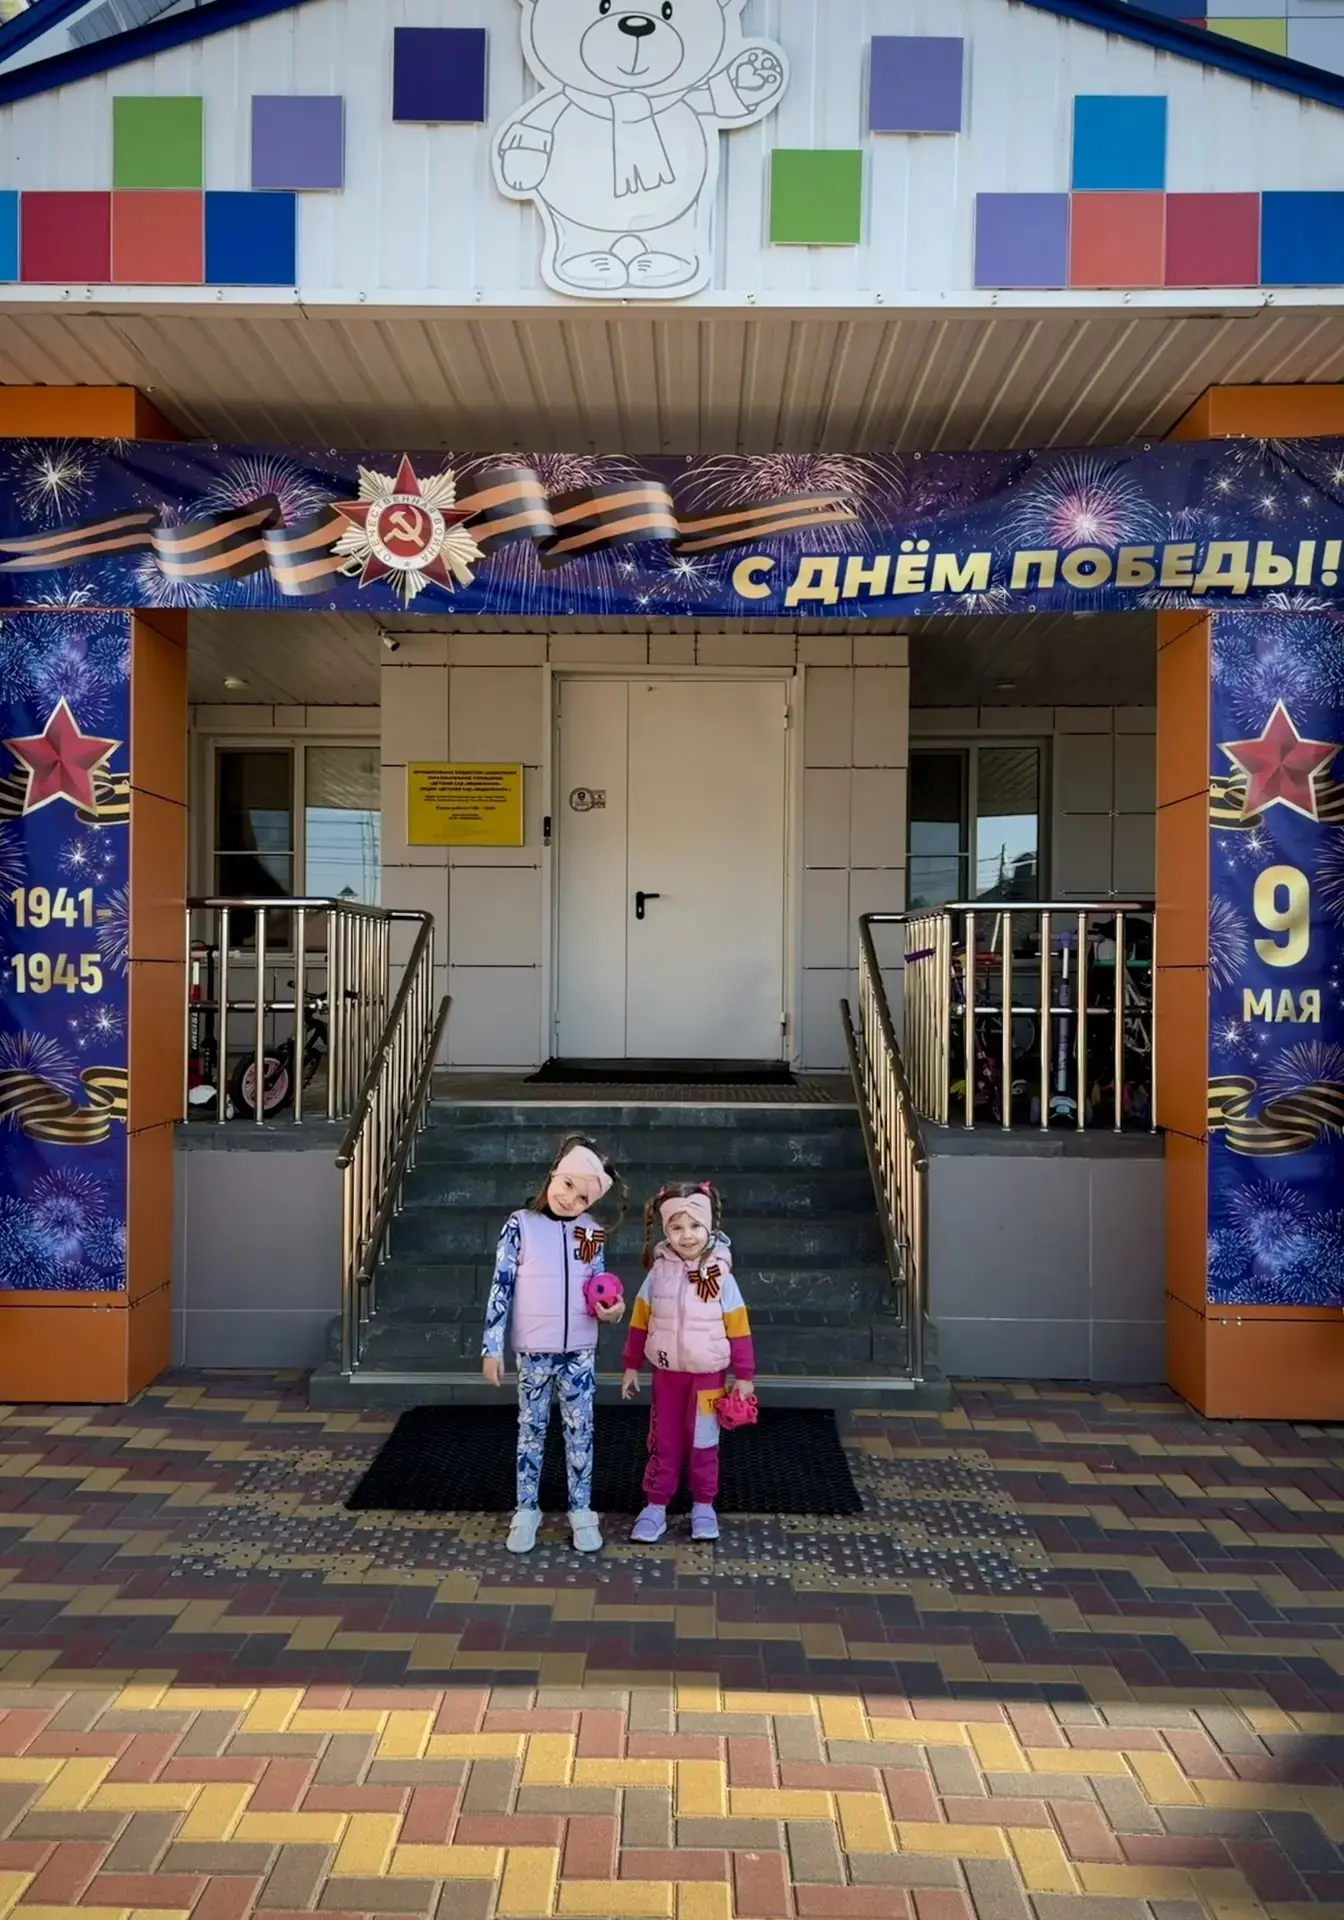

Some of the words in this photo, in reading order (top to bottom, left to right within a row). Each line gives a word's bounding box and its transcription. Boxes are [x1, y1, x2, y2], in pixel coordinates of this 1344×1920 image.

[367, 495, 436, 563] ОТЕЧЕСТВЕННАЯ
[732, 556, 776, 600] С
[784, 539, 992, 608] ДНЁМ
[1009, 539, 1343, 595] ПОБЕДЫ!
[1253, 865, 1310, 967] 9
[11, 952, 103, 994] 1945
[1243, 988, 1321, 1023] МАЯ
